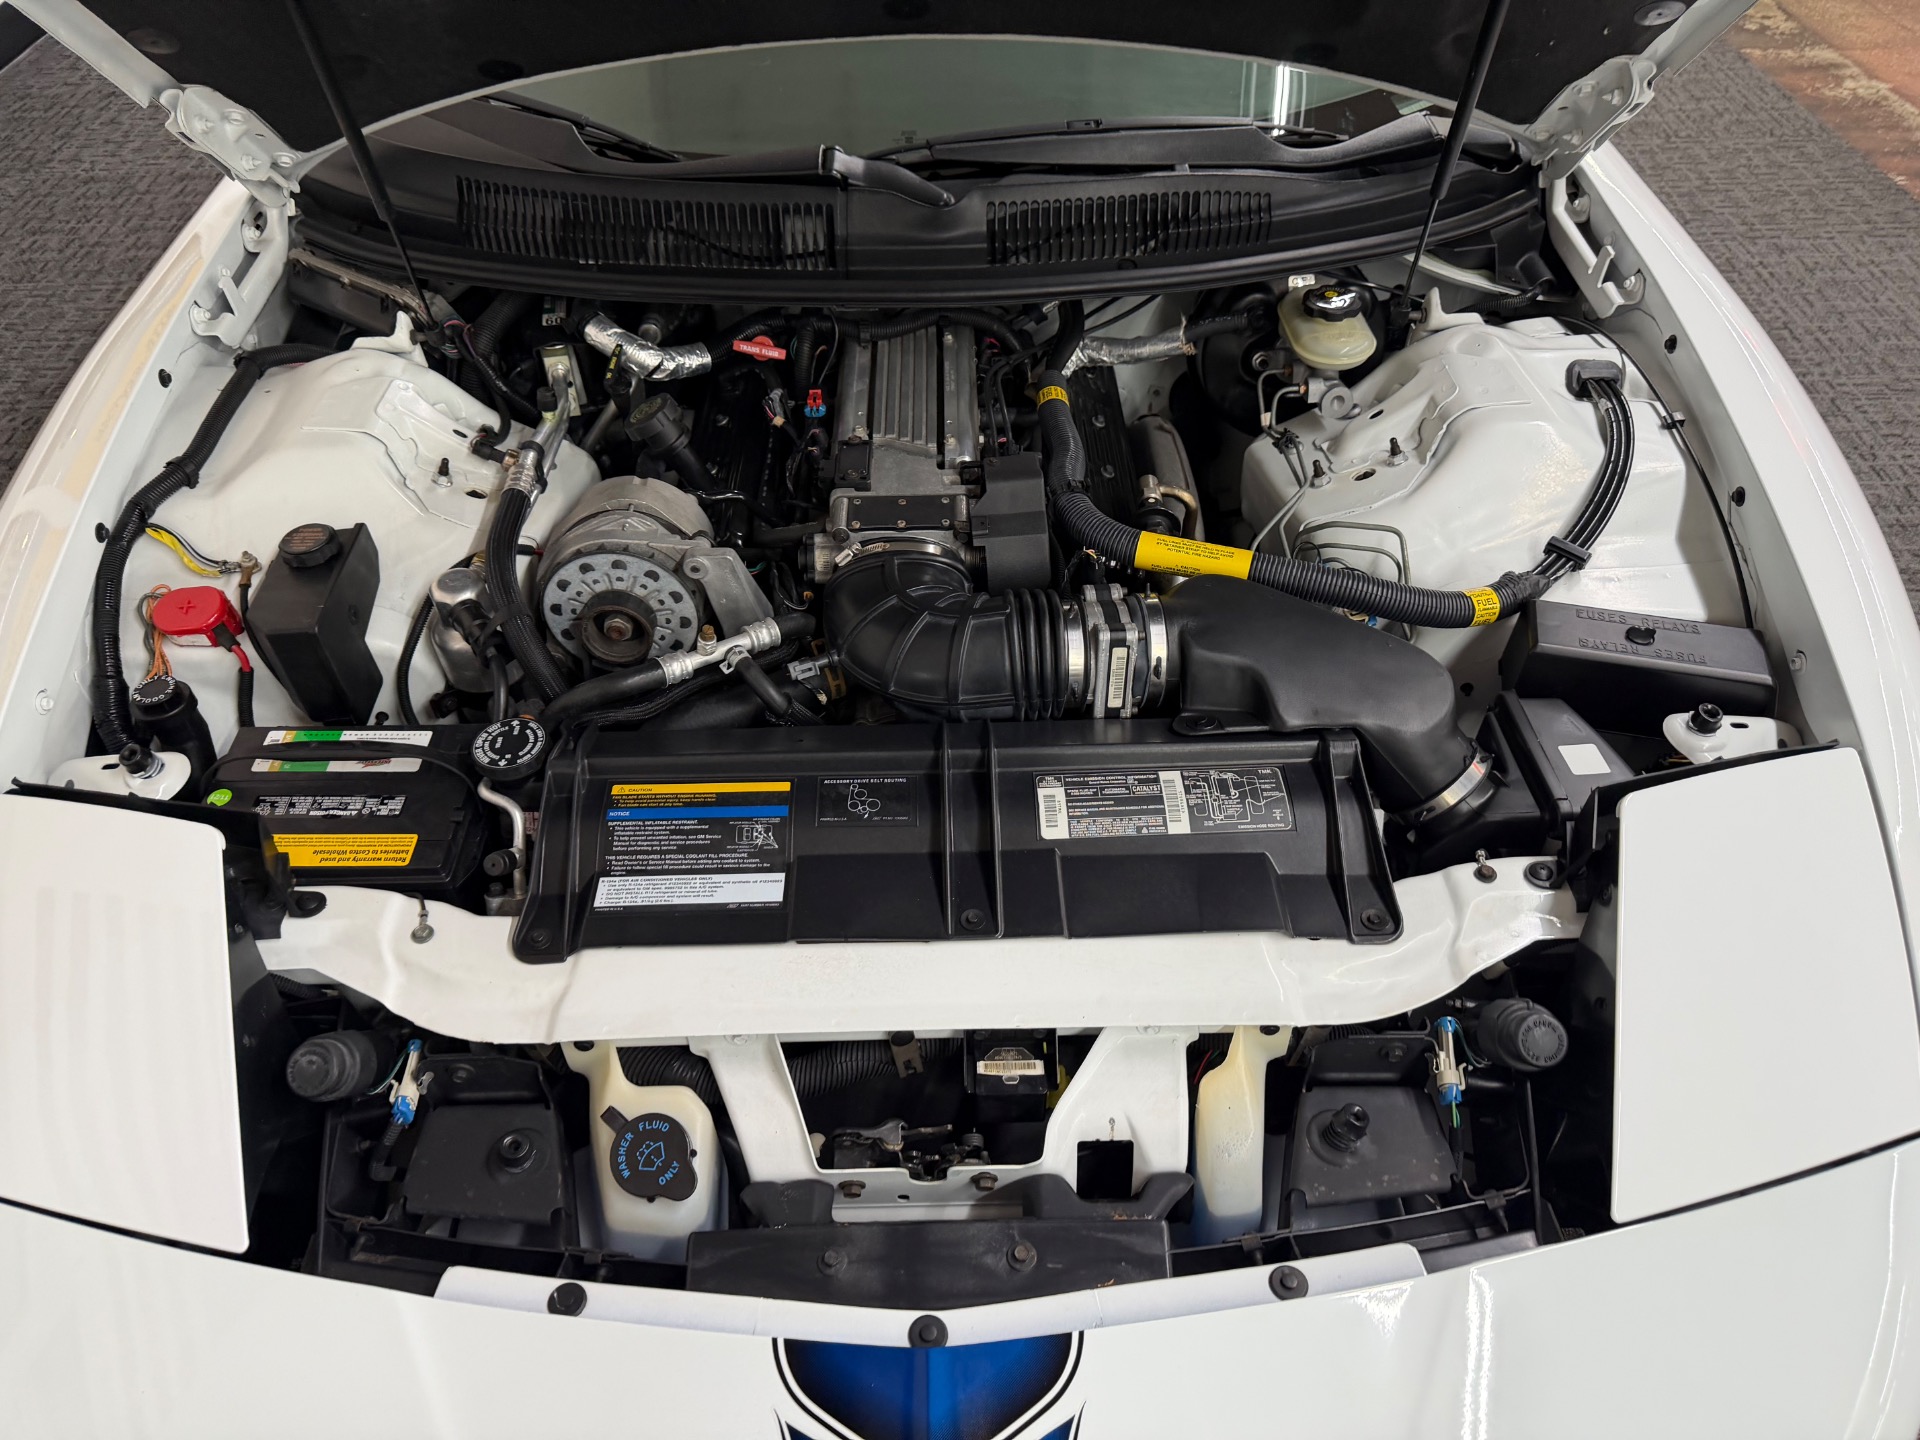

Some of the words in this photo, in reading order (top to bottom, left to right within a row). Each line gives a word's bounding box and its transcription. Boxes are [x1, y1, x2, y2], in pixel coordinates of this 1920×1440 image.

[739, 344, 760, 354] TRANS
[761, 348, 779, 357] FLUID
[1167, 548, 1190, 556] POTENTIAL
[1477, 598, 1497, 607] FUEL
[1576, 608, 1626, 624] FUSES
[1640, 618, 1701, 634] RELAYS
[1579, 637, 1638, 655] RELAYS
[1654, 648, 1707, 664] FUSES
[136, 675, 159, 689] ONLY
[487, 722, 501, 733] HOT
[475, 732, 489, 748] OPEN
[475, 748, 491, 764] NEVER
[617, 1132, 634, 1179] WASHER
[638, 1120, 670, 1132] FLUID
[659, 1161, 680, 1185] ONLY
